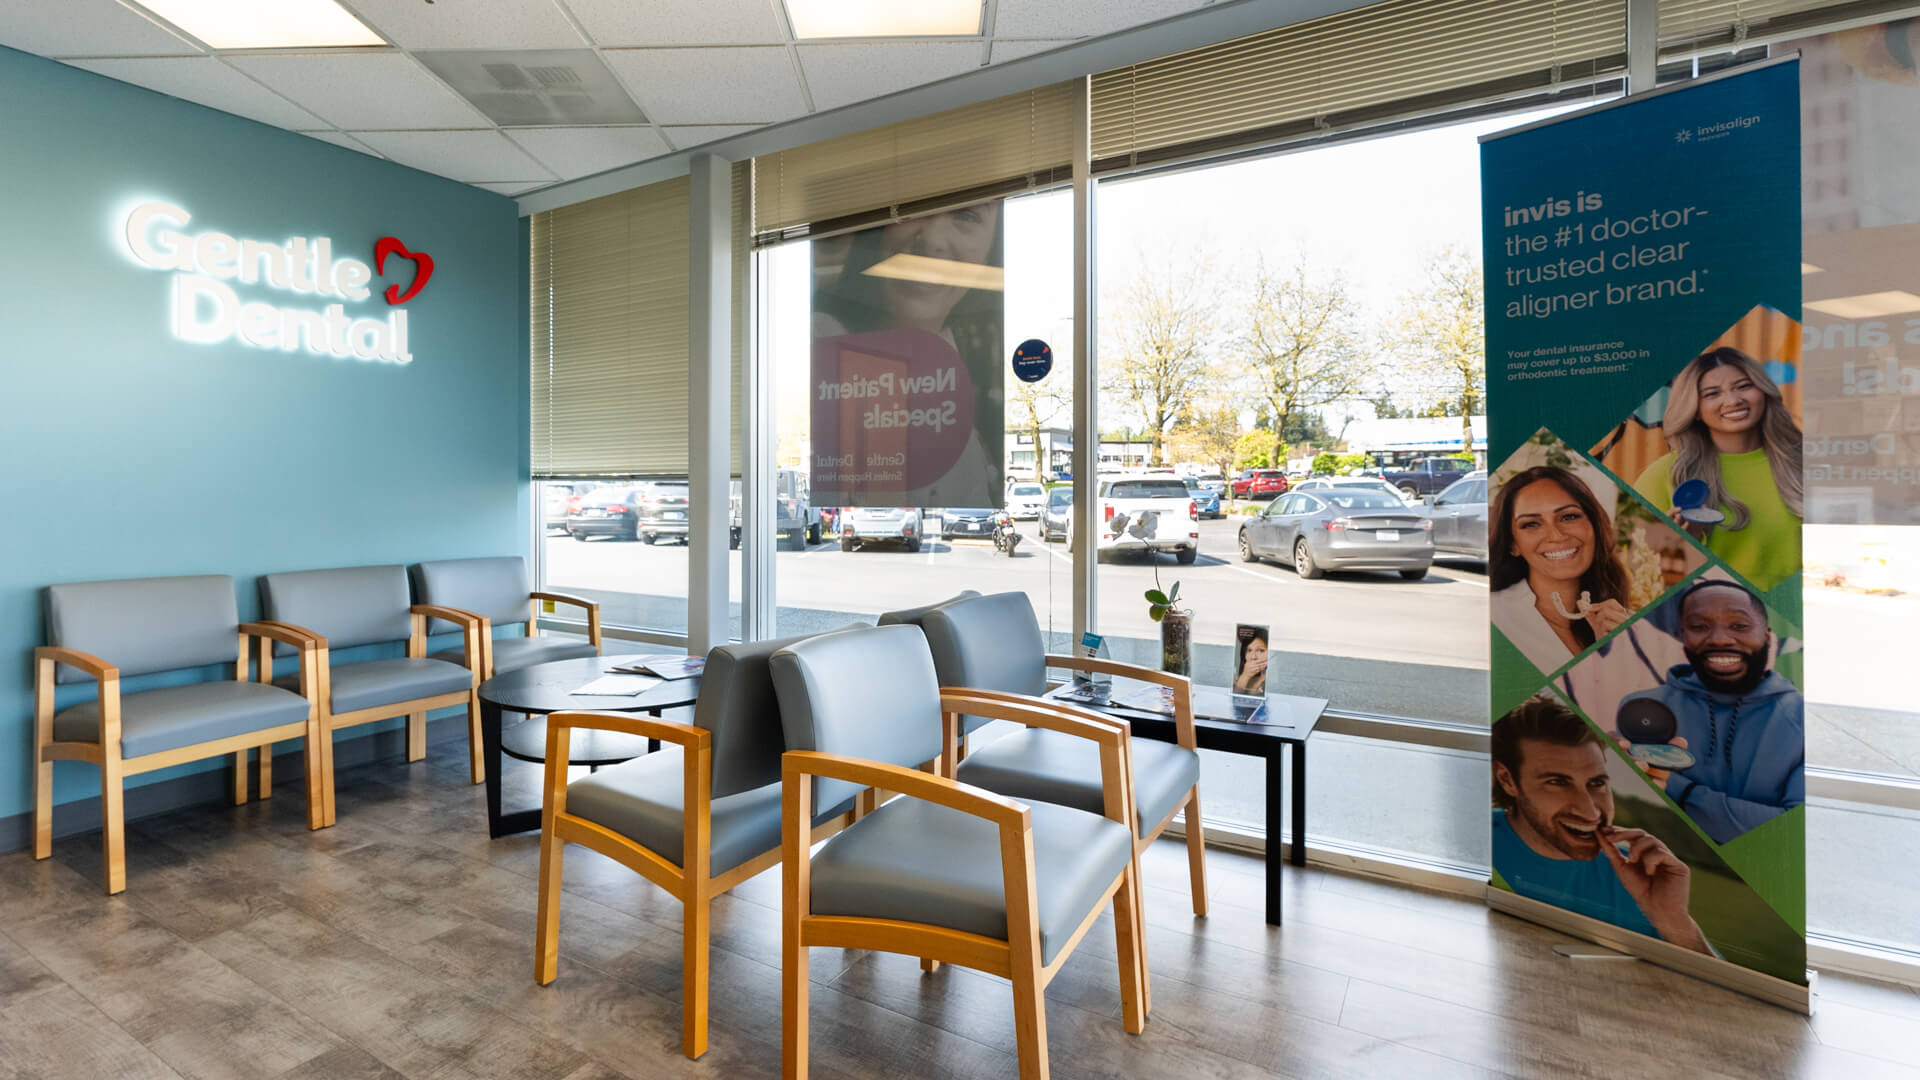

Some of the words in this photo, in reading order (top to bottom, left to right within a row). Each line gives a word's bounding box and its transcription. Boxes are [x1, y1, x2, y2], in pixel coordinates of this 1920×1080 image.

[1697, 114, 1760, 136] invisalign
[1504, 197, 1570, 227] invis
[1577, 190, 1602, 212] is
[1506, 234, 1548, 256] the
[1554, 224, 1584, 248] #1
[1591, 206, 1708, 242] doctor-
[126, 201, 372, 300] Gentle
[1506, 251, 1604, 286] trusted
[1612, 241, 1690, 270] clear
[176, 274, 413, 363] Dental
[1506, 288, 1600, 319] aligner
[1507, 360, 1528, 371] may
[1530, 358, 1560, 368] cover
[1562, 356, 1576, 366] up
[1580, 354, 1591, 363] to
[1594, 349, 1636, 362] $3,000
[1639, 349, 1650, 358] in
[1508, 350, 1531, 359] Your
[1533, 345, 1566, 356] dental
[1569, 340, 1624, 351] insurance
[1507, 368, 1568, 381] orthodontic
